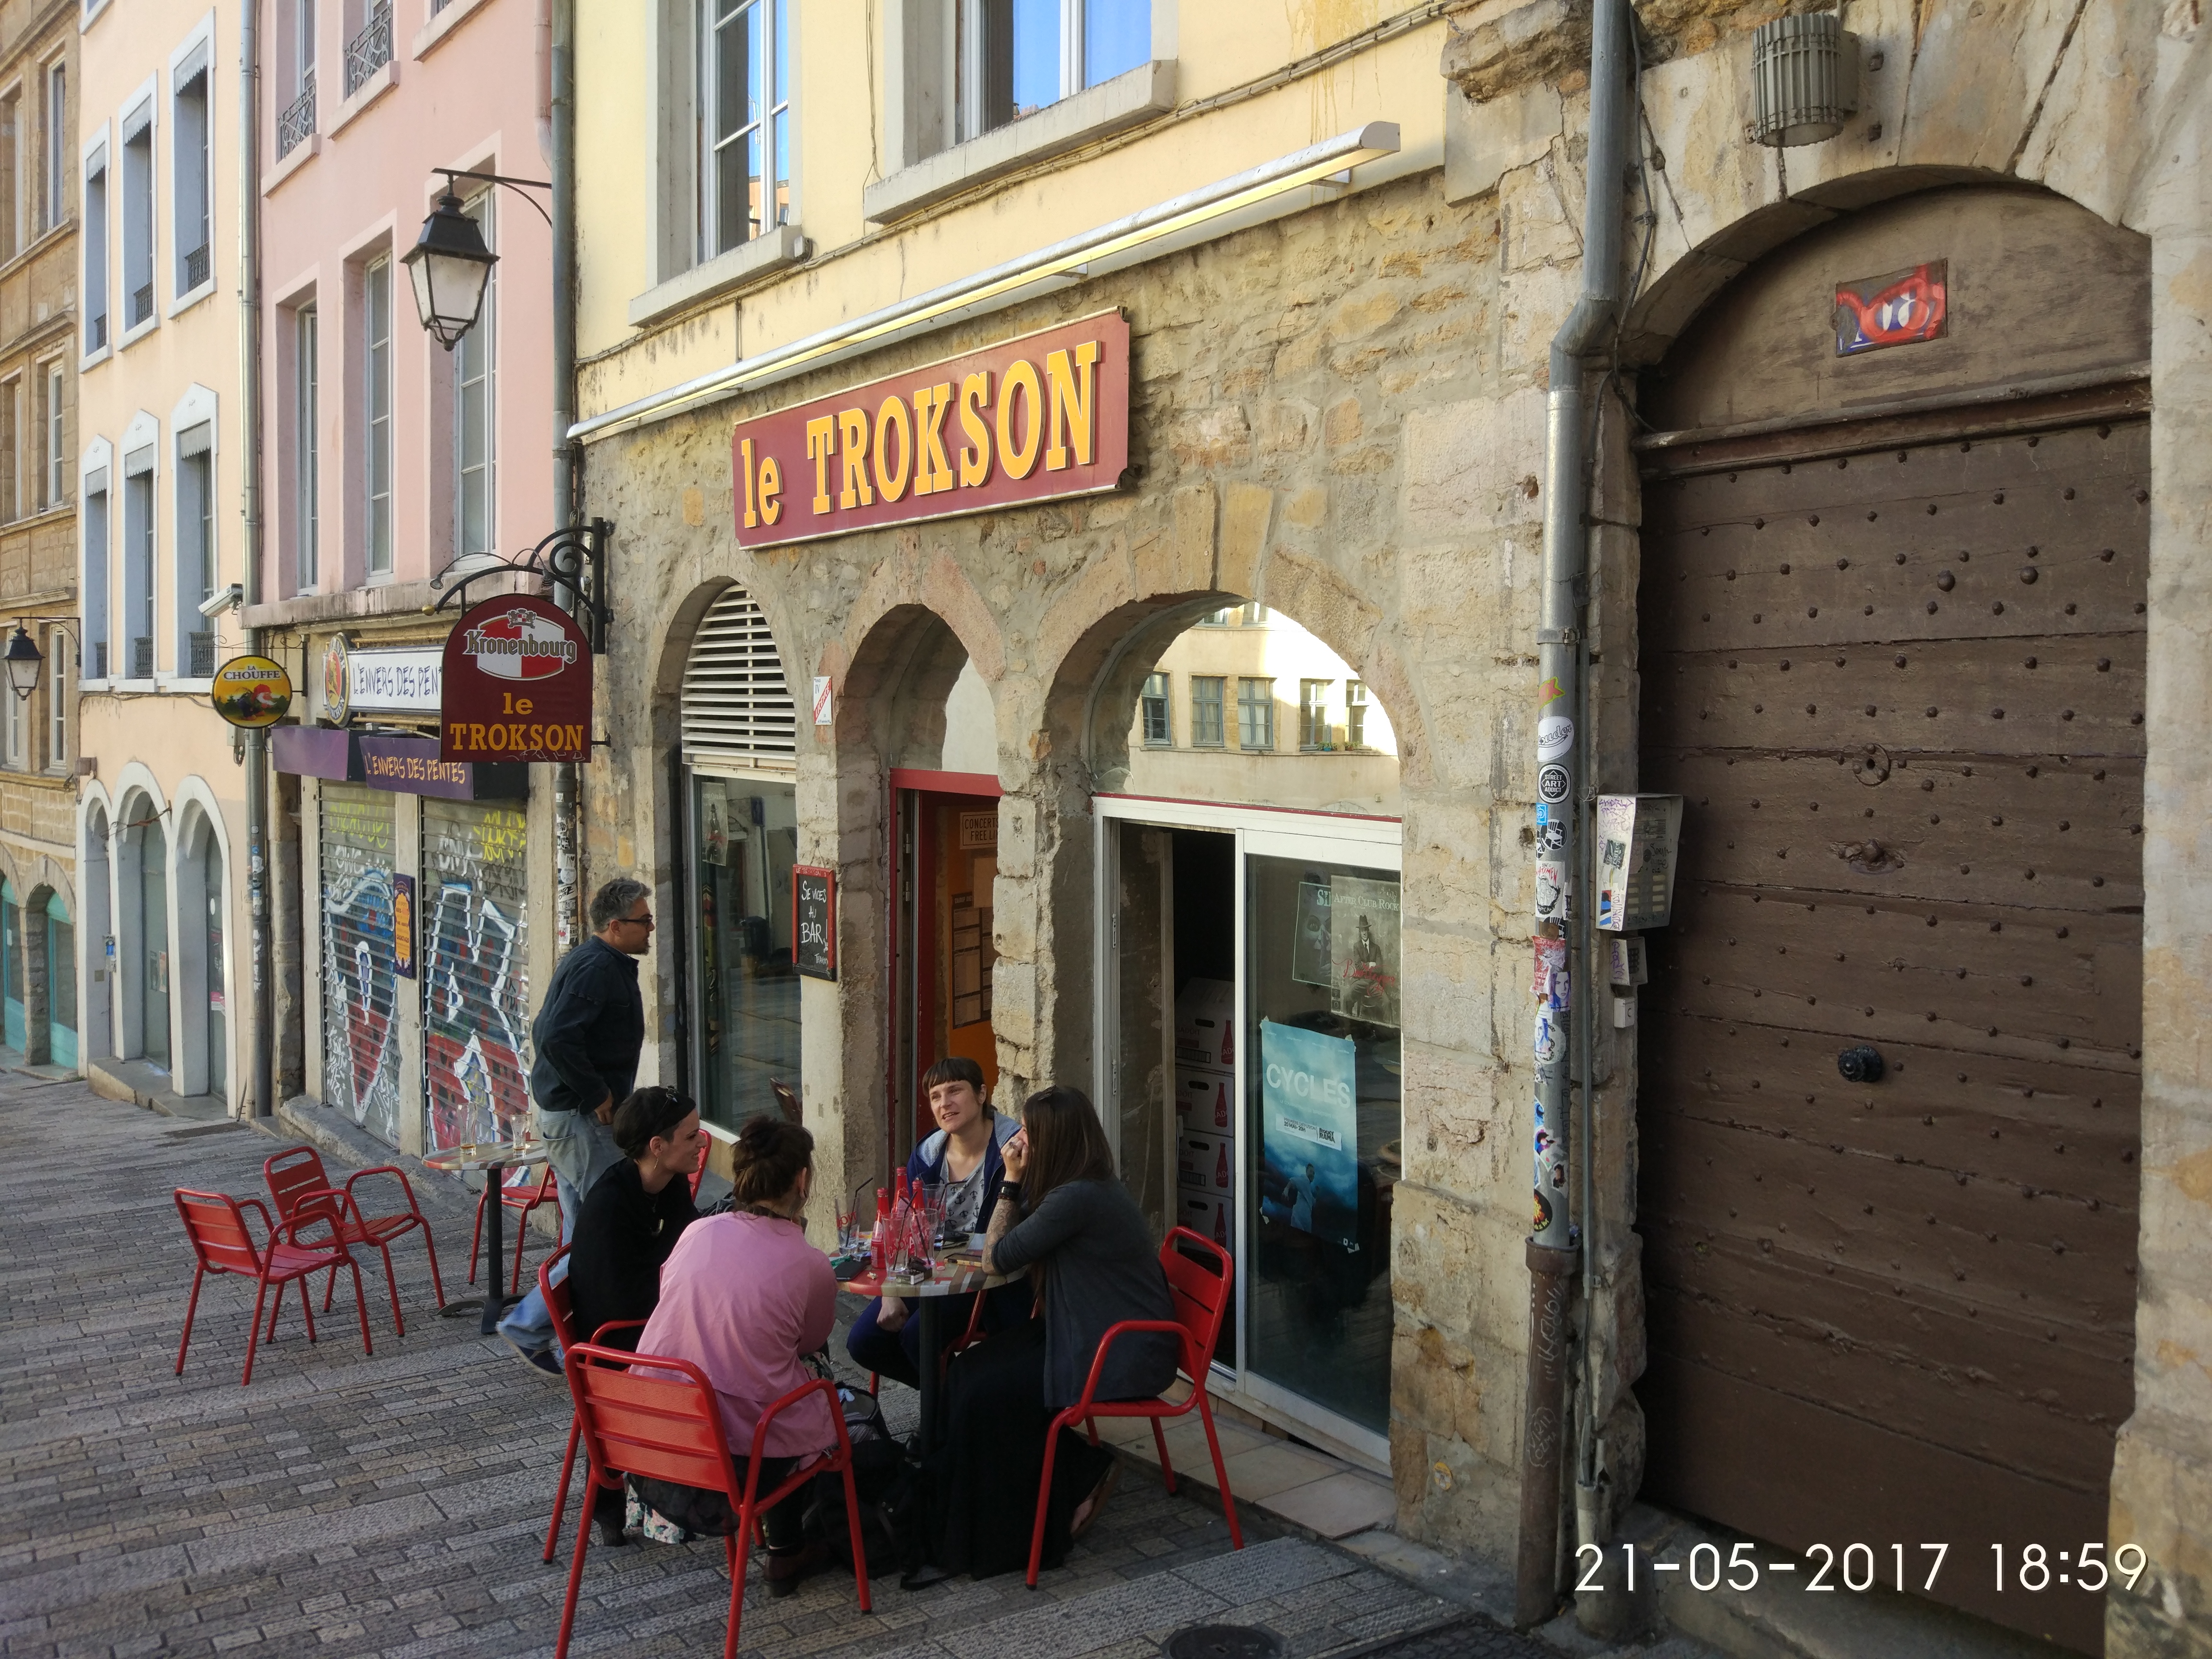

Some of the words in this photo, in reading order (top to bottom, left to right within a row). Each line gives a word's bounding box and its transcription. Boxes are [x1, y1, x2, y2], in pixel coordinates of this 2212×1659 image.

[741, 438, 783, 528] le
[806, 339, 1101, 515] TROKSON
[463, 629, 577, 663] Kronenbourg
[223, 671, 280, 680] CHOUFFE
[353, 662, 393, 697] L'ENVERS
[396, 666, 415, 697] DES
[418, 665, 442, 699] PEN
[503, 692, 533, 715] le
[816, 682, 830, 719] LICENCE
[450, 723, 584, 751] TROKSON
[364, 752, 405, 779] L'ENVERS
[407, 757, 425, 781] DES
[427, 759, 466, 784] PENTES
[971, 830, 987, 841] FREE
[808, 905, 817, 918] AU
[1334, 892, 1357, 906] AFTER
[1358, 895, 1377, 909] CLUB
[1378, 898, 1400, 912] ROCK
[1266, 1063, 1351, 1109] CYCLES
[1319, 1133, 1335, 1143] RAMA
